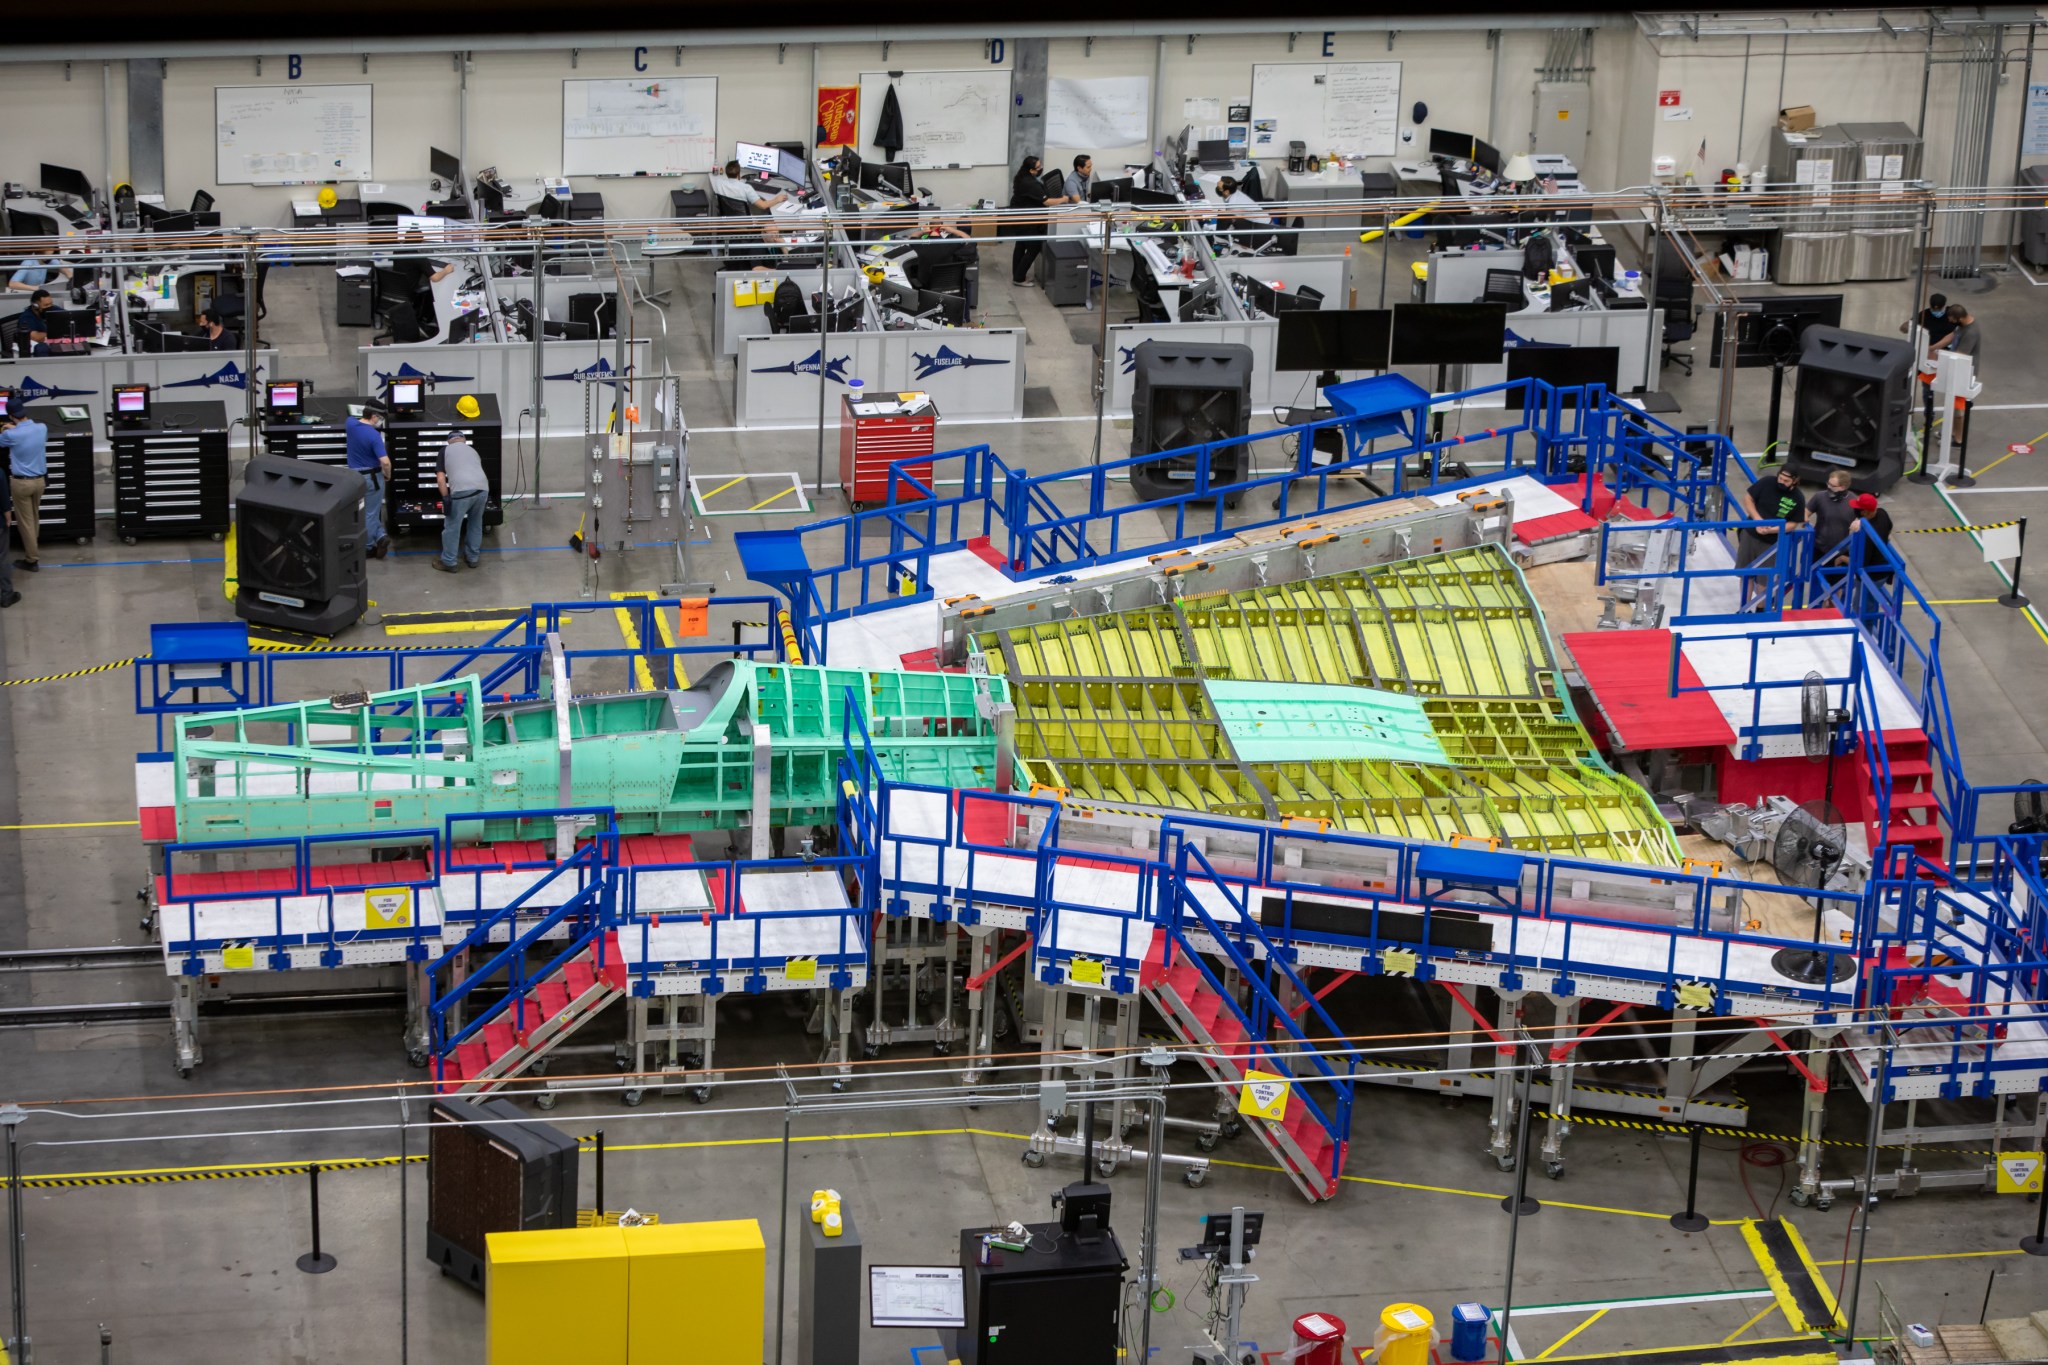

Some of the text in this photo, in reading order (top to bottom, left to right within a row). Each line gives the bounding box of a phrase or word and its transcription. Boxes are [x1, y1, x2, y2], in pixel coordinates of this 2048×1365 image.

[1322, 31, 1336, 57] E
[991, 38, 1004, 64] D
[634, 46, 648, 72] C
[288, 54, 302, 79] B
[934, 357, 963, 366] FUSELAGE
[794, 363, 828, 372] EMPENNAE
[219, 374, 240, 383] NASA
[573, 372, 586, 380] SUB
[32, 388, 49, 397] TEAM
[1255, 1089, 1275, 1097] CONTROL
